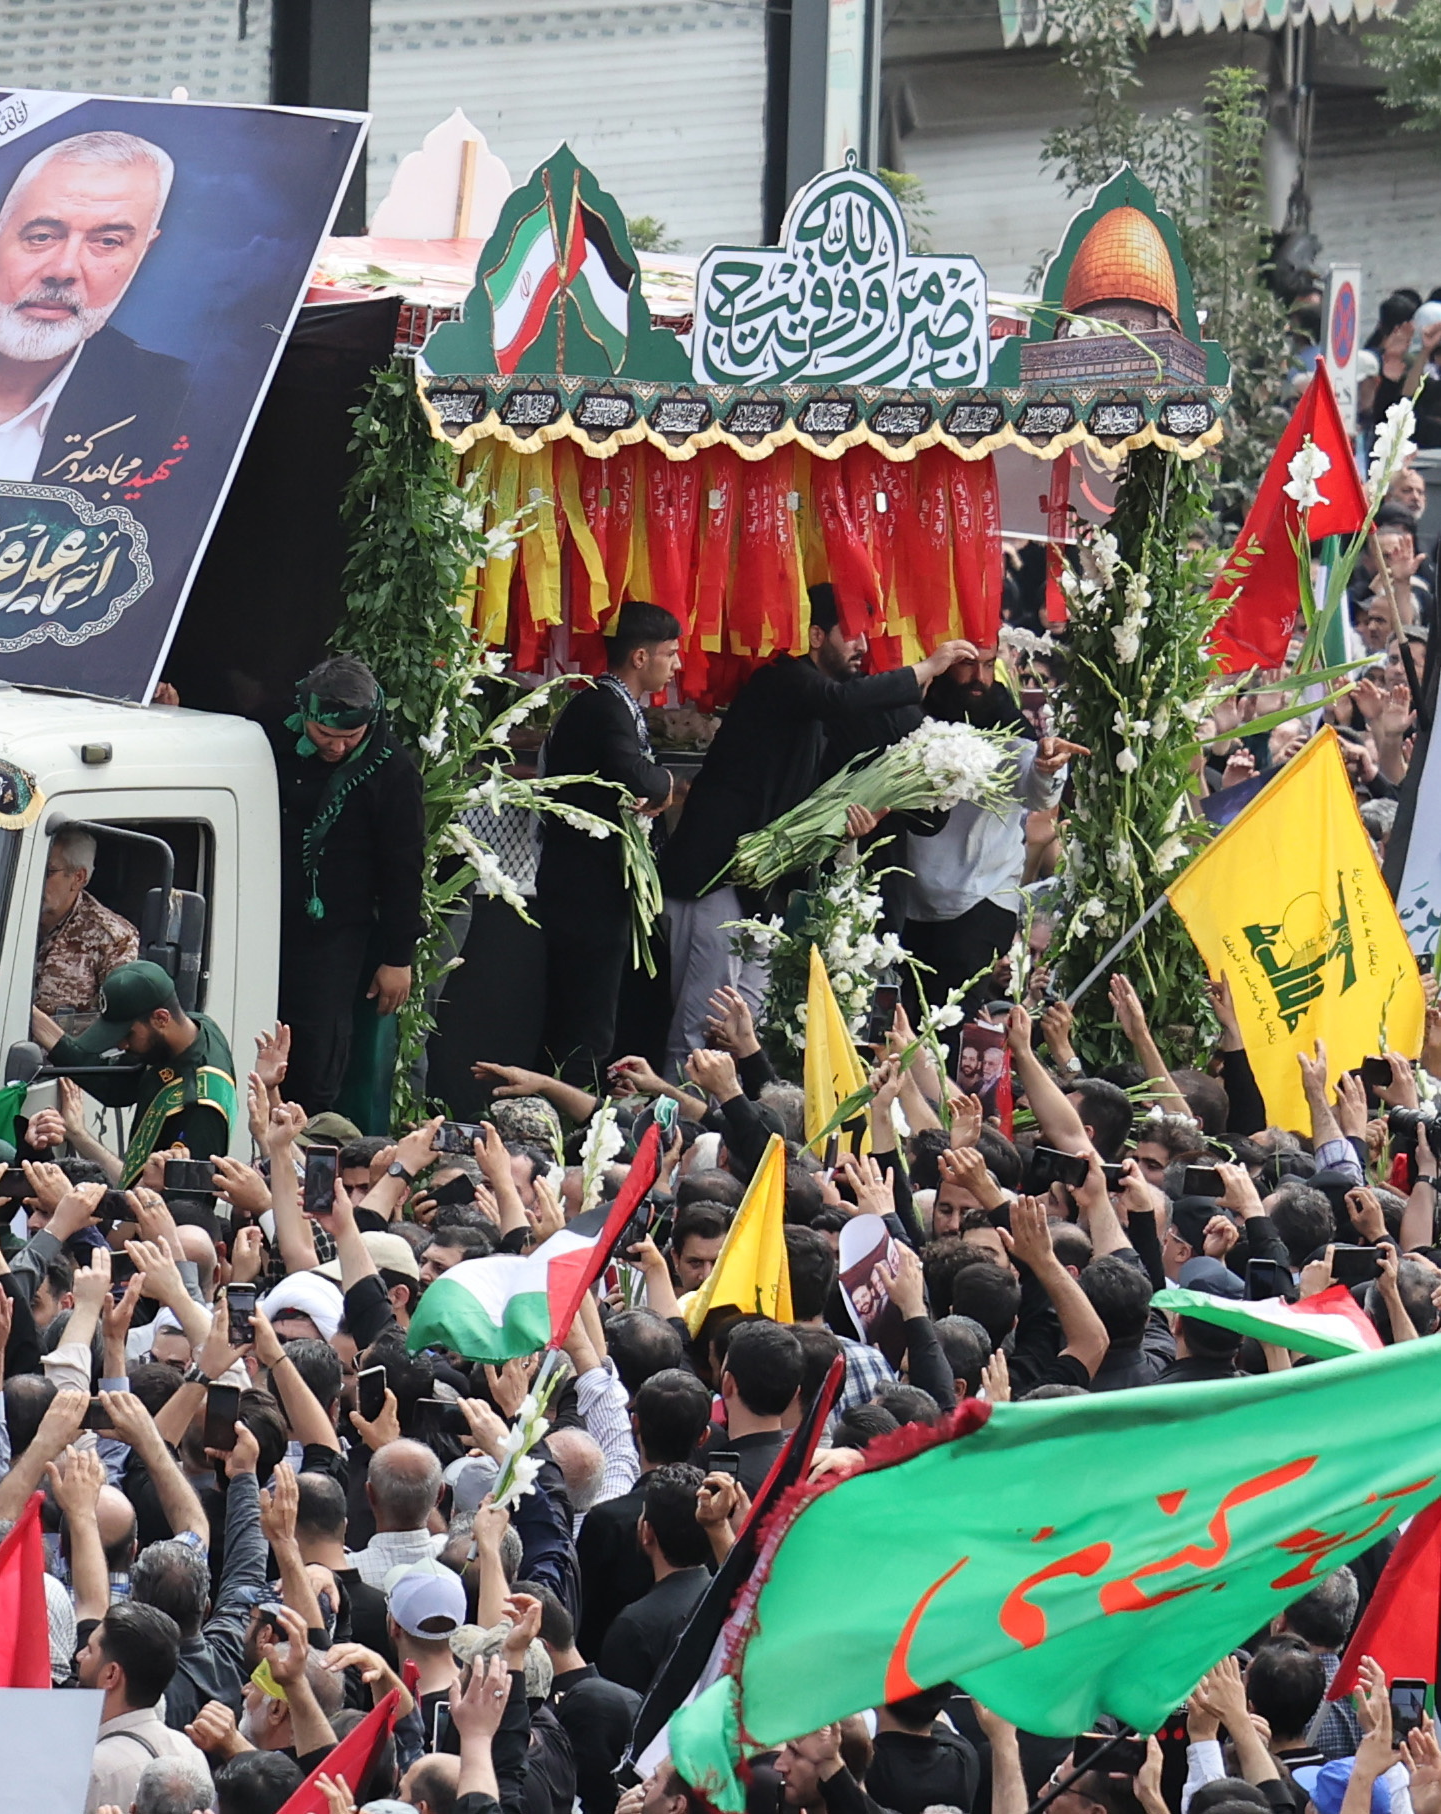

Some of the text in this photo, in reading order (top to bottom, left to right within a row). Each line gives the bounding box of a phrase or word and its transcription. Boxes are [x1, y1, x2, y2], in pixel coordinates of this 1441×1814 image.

[42, 414, 190, 500] شهید مجاهد دکتر
